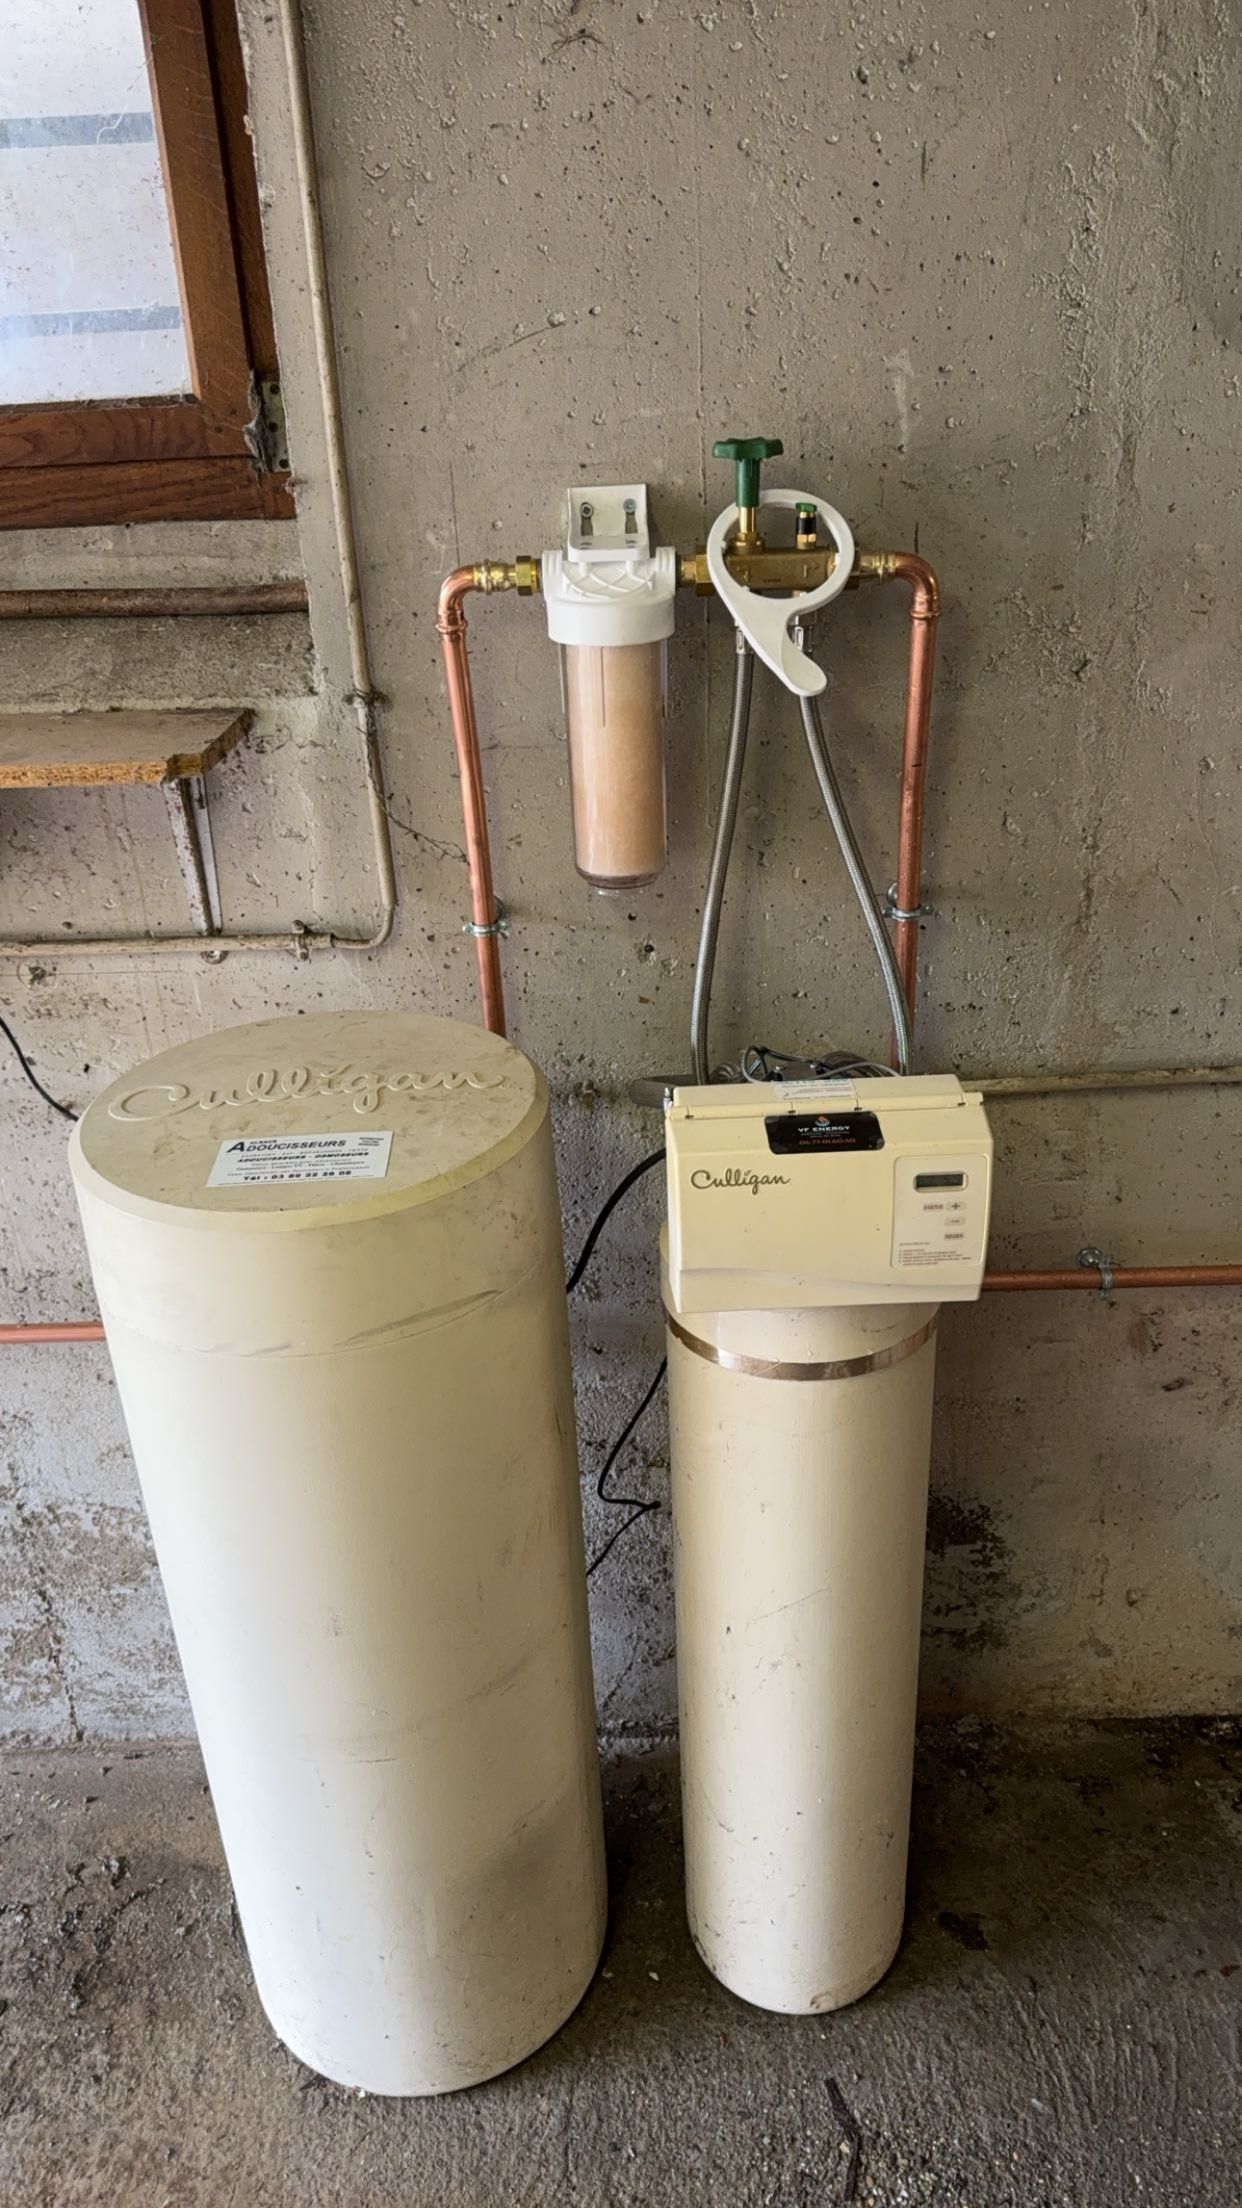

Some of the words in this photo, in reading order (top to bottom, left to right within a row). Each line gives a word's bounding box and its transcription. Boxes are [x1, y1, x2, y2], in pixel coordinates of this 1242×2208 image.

[107, 1064, 506, 1121] Culligan
[226, 1140, 346, 1153] ADOUCISSEURS
[237, 1155, 306, 1163] ADOUCISSEURS
[690, 1168, 791, 1195] Culligan
